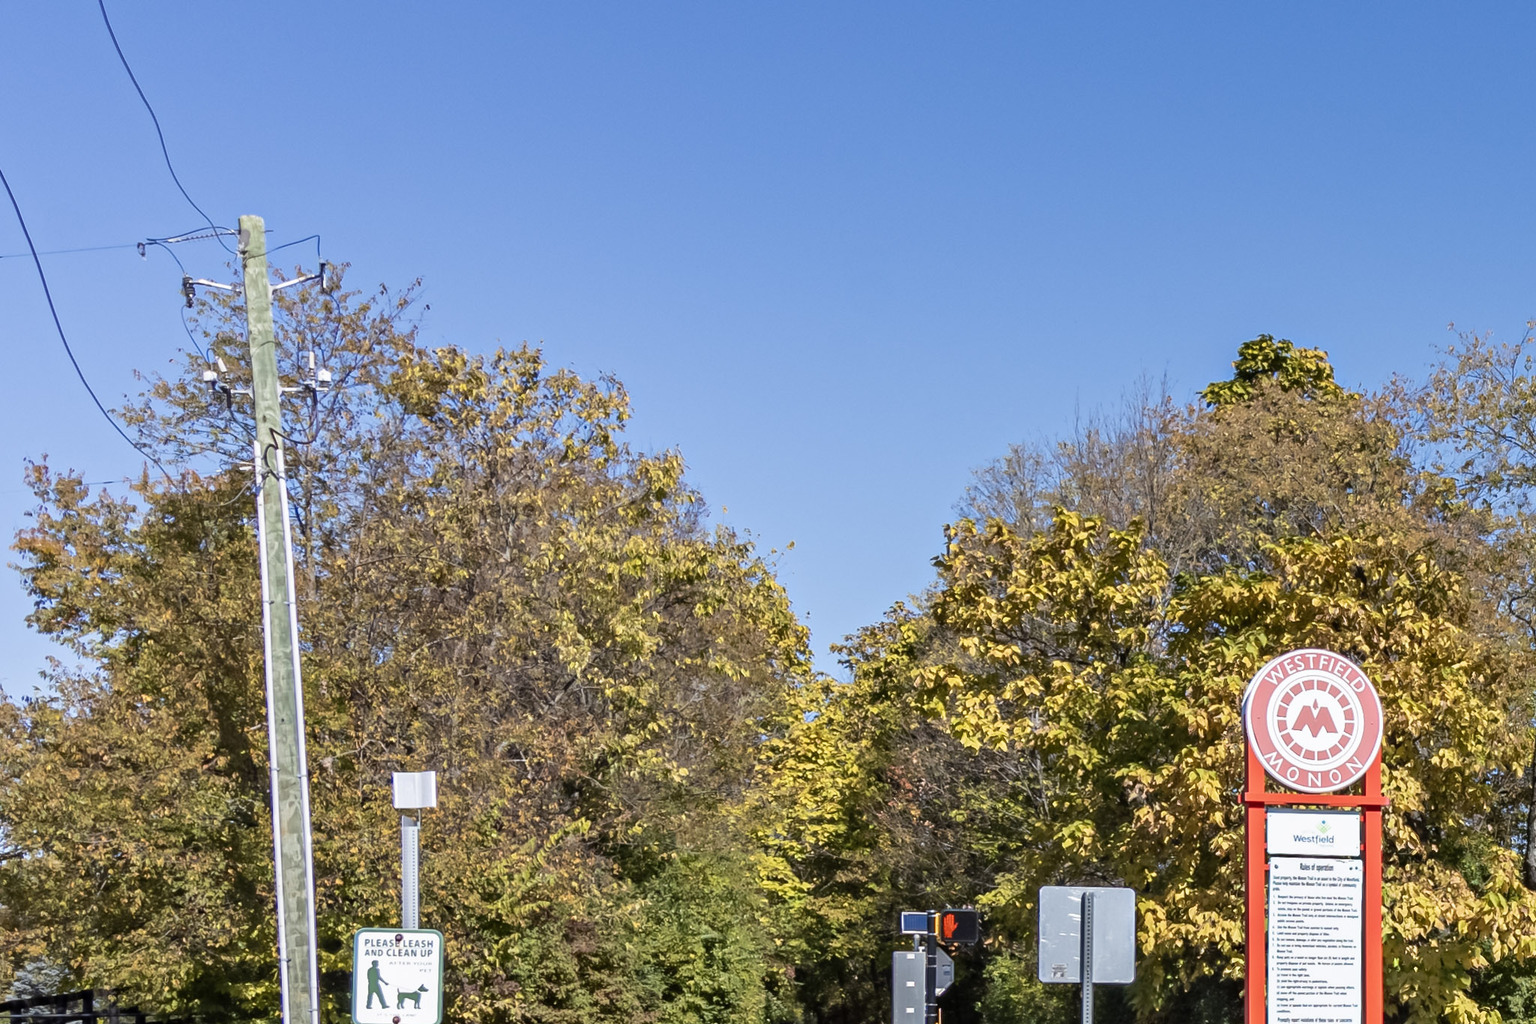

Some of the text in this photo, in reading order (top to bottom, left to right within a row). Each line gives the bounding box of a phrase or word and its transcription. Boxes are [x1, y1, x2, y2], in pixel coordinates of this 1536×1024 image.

[1265, 654, 1366, 693] WESTFIELD
[1264, 751, 1363, 787] MONON
[1293, 834, 1335, 844] Westfield
[365, 939, 434, 948] PLEASE LEASH
[365, 949, 433, 957] AND CLEAN UP
